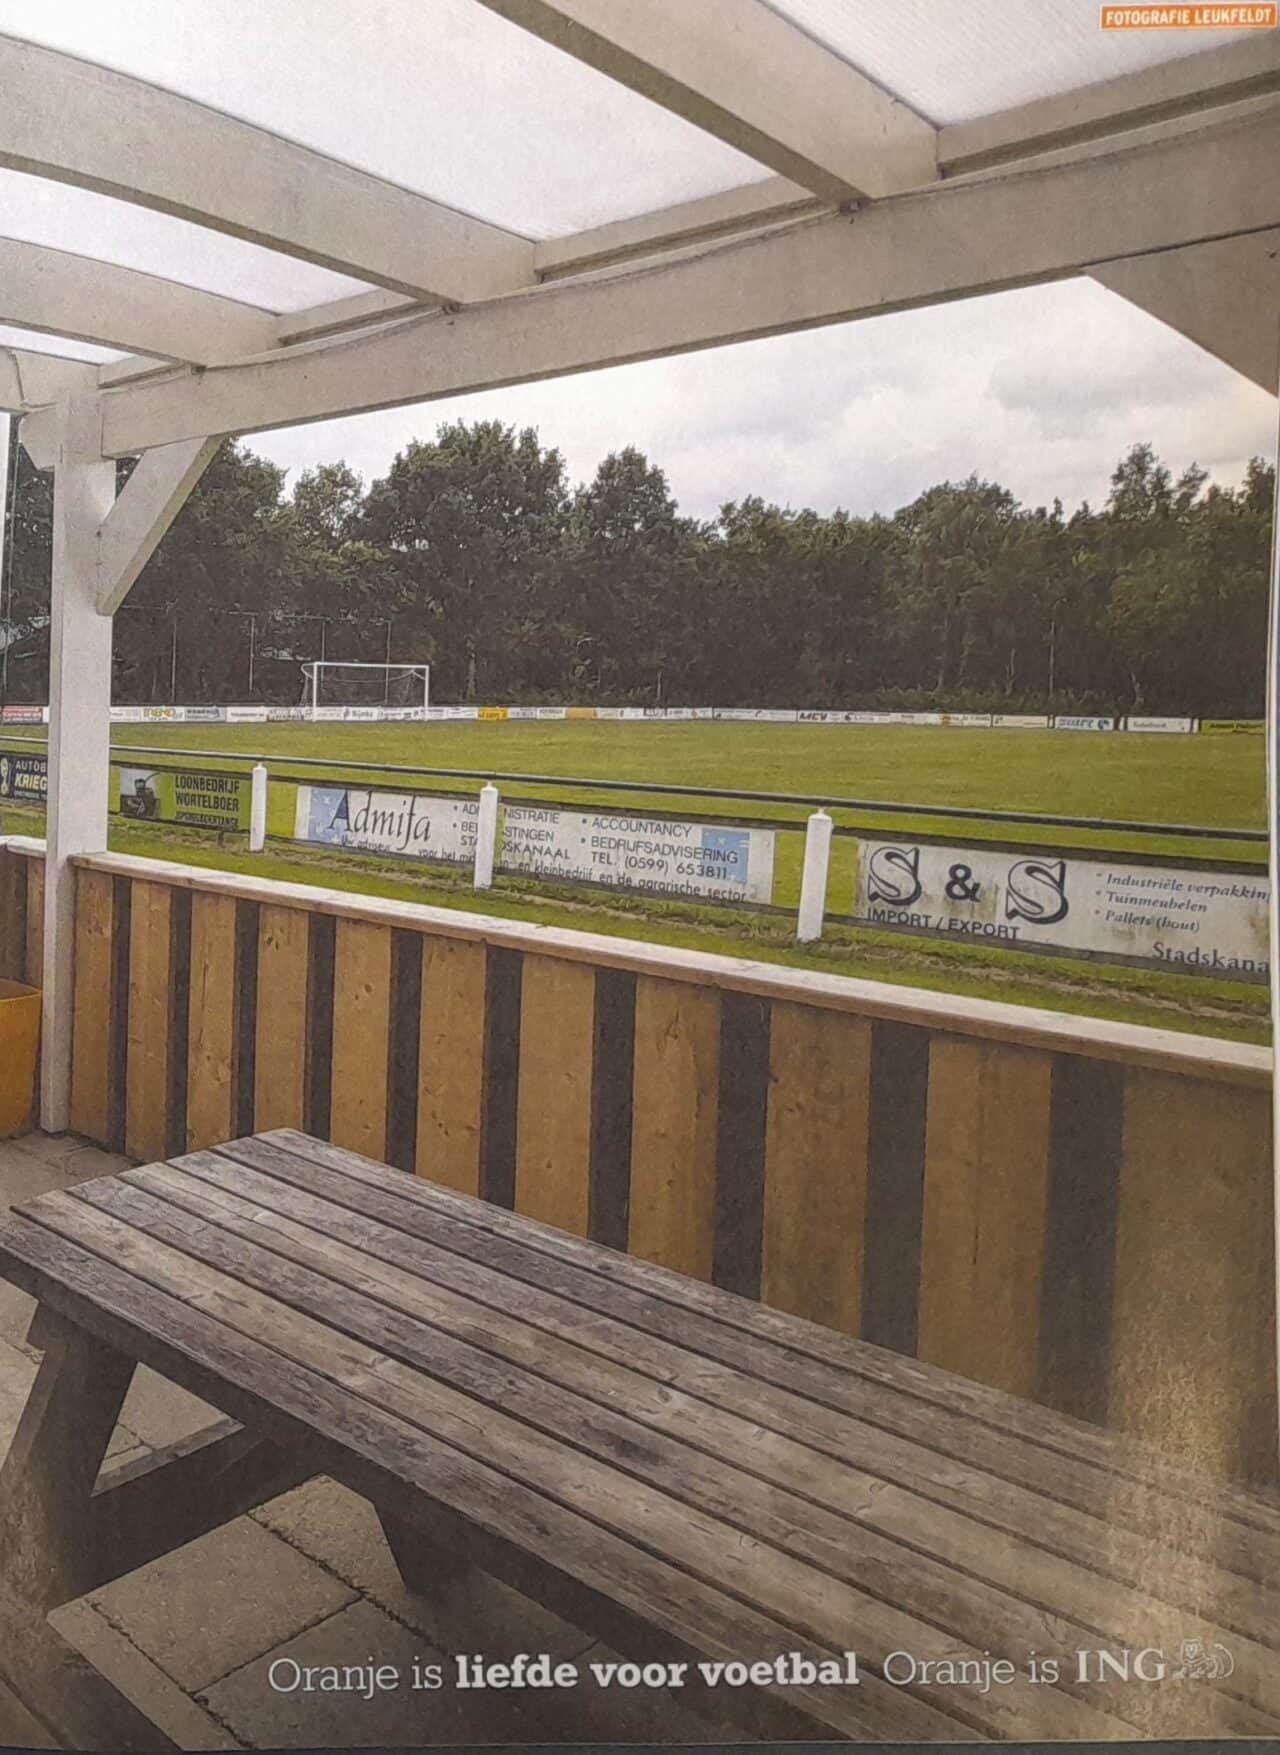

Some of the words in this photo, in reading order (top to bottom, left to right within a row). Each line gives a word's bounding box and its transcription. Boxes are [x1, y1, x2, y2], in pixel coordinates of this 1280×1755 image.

[1106, 9, 1190, 26] FOTOGRAFIE
[1195, 8, 1272, 24] LEUKFELDT
[175, 775, 240, 793] LOONBEDRIJF
[176, 792, 239, 812] WORTELBOER
[463, 803, 560, 824] ADNISTRATIE
[592, 817, 693, 838] ACCOUNTANCY
[592, 852, 617, 866] TEL.
[625, 855, 669, 876] (0599)
[676, 863, 727, 880] 653811
[868, 846, 922, 906] S
[945, 863, 982, 902] &
[1006, 860, 1069, 924] S
[1106, 873, 1183, 892] Industriële
[1106, 890, 1209, 913] Tuinmeubelen
[1105, 909, 1152, 926] Pallets
[1156, 916, 1201, 933] (hout)
[268, 1656, 400, 1699] Oranje
[412, 1656, 443, 1689] is
[456, 1654, 578, 1689] liefde
[590, 1663, 688, 1688] voor
[698, 1651, 860, 1688] voetbal
[883, 1651, 1016, 1693] Oranje
[1028, 1650, 1060, 1684] is
[1075, 1648, 1168, 1683] ING
